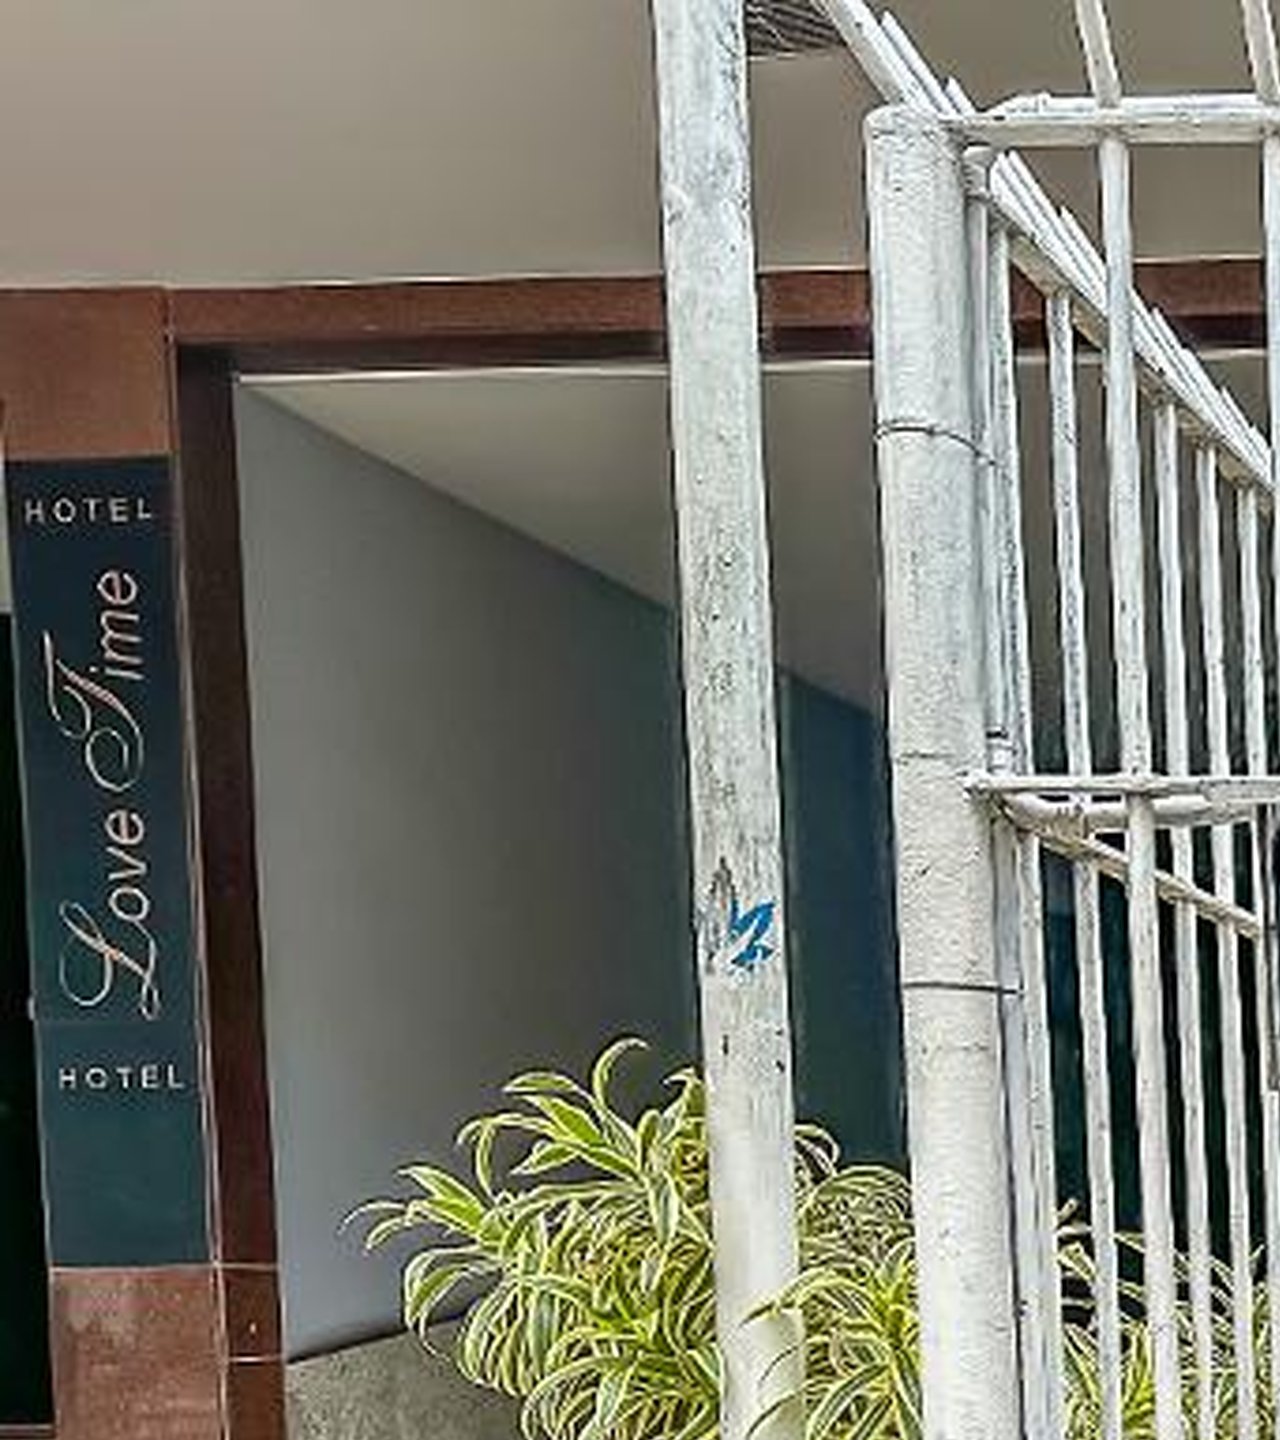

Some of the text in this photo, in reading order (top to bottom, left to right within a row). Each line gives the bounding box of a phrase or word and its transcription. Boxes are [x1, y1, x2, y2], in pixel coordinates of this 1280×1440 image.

[24, 497, 153, 523] HOTEL
[42, 568, 160, 1020] Love Time
[58, 1064, 185, 1090] HOTEL
